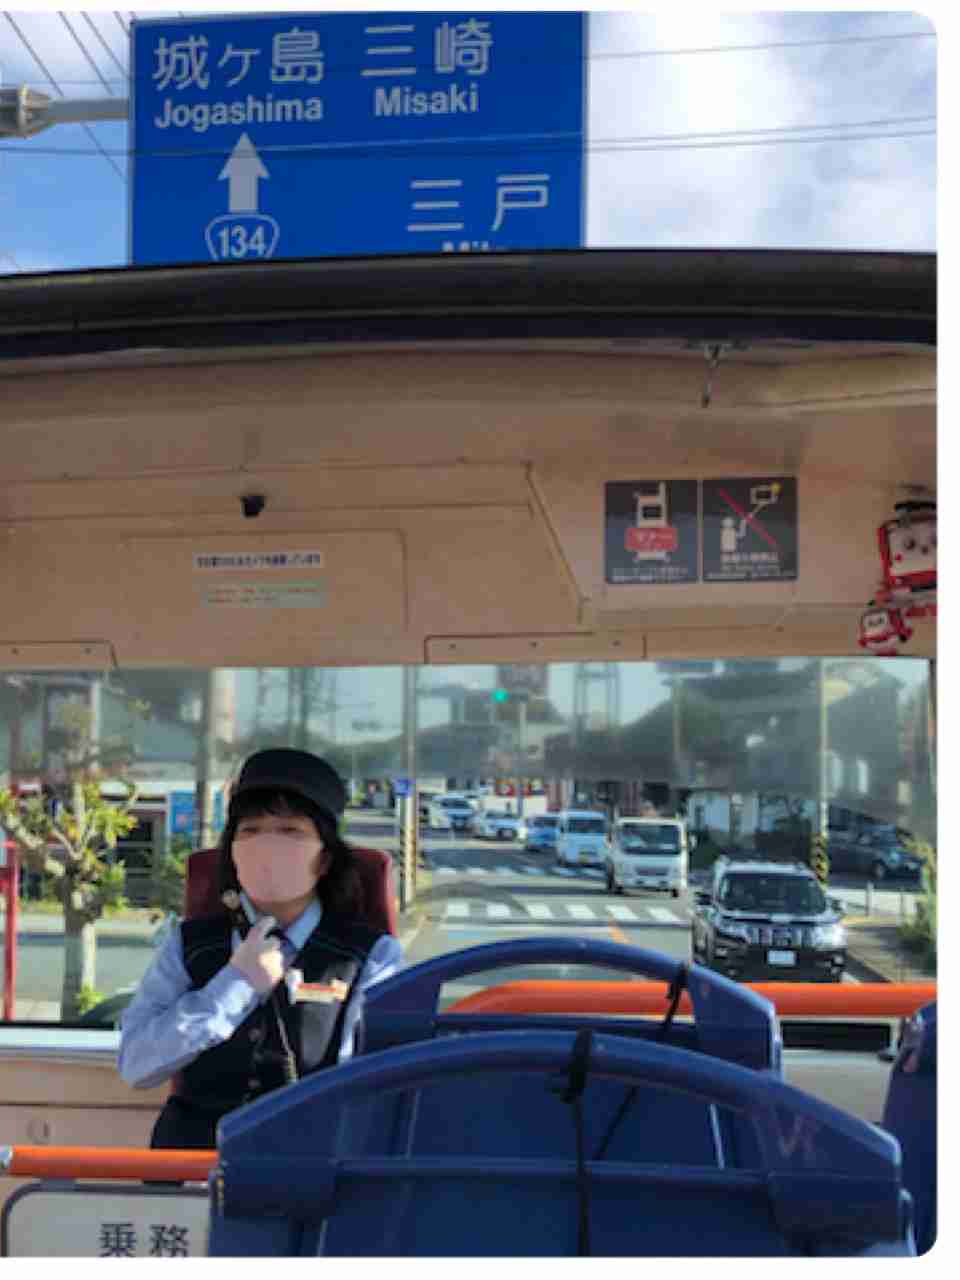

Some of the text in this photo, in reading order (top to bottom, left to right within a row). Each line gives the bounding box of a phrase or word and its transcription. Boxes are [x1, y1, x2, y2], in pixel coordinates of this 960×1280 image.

[360, 17, 493, 77] 三崎
[153, 83, 480, 133] Jogashima Misaki
[406, 173, 550, 232] 三戸
[216, 224, 267, 259] 134
[98, 1223, 189, 1257] 乗務
